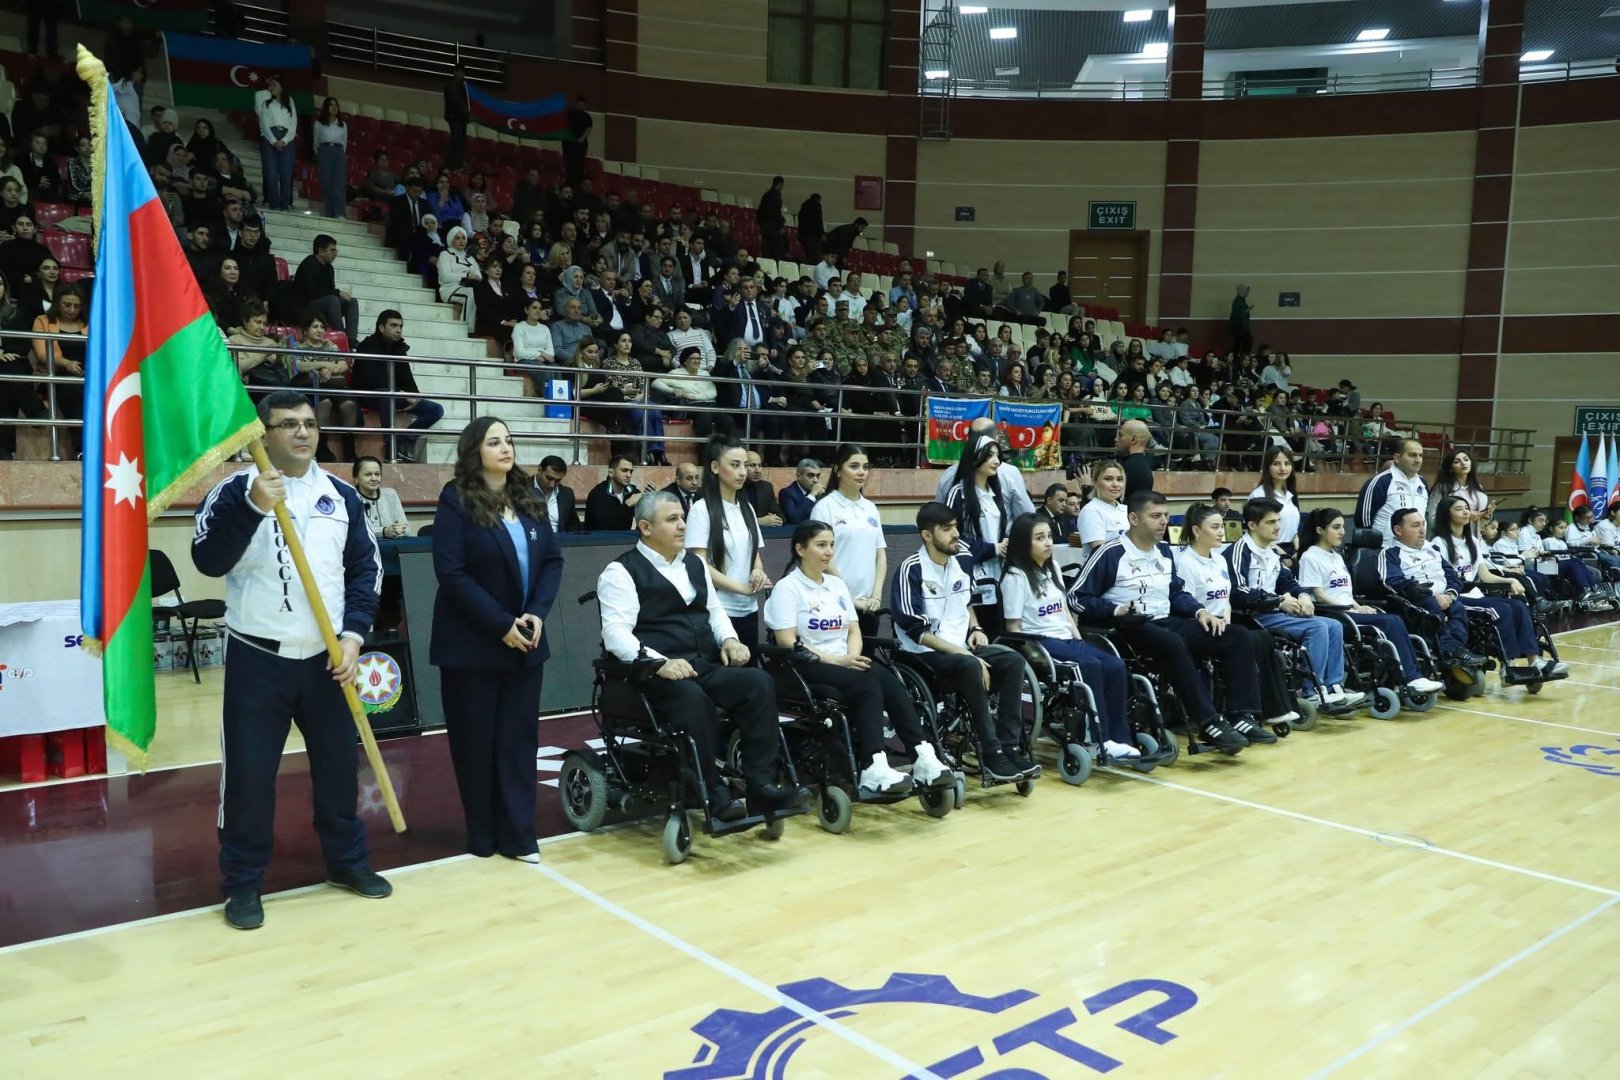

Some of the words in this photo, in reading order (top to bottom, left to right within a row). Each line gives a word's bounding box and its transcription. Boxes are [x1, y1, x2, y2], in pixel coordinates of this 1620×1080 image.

[1096, 206, 1129, 216] ÇIXIŞ
[1099, 216, 1126, 224] EXIT
[1587, 422, 1620, 431] EXIT
[1329, 575, 1349, 588] seni
[1206, 586, 1228, 600] seni
[1038, 599, 1063, 617] seni
[808, 614, 842, 631] seni
